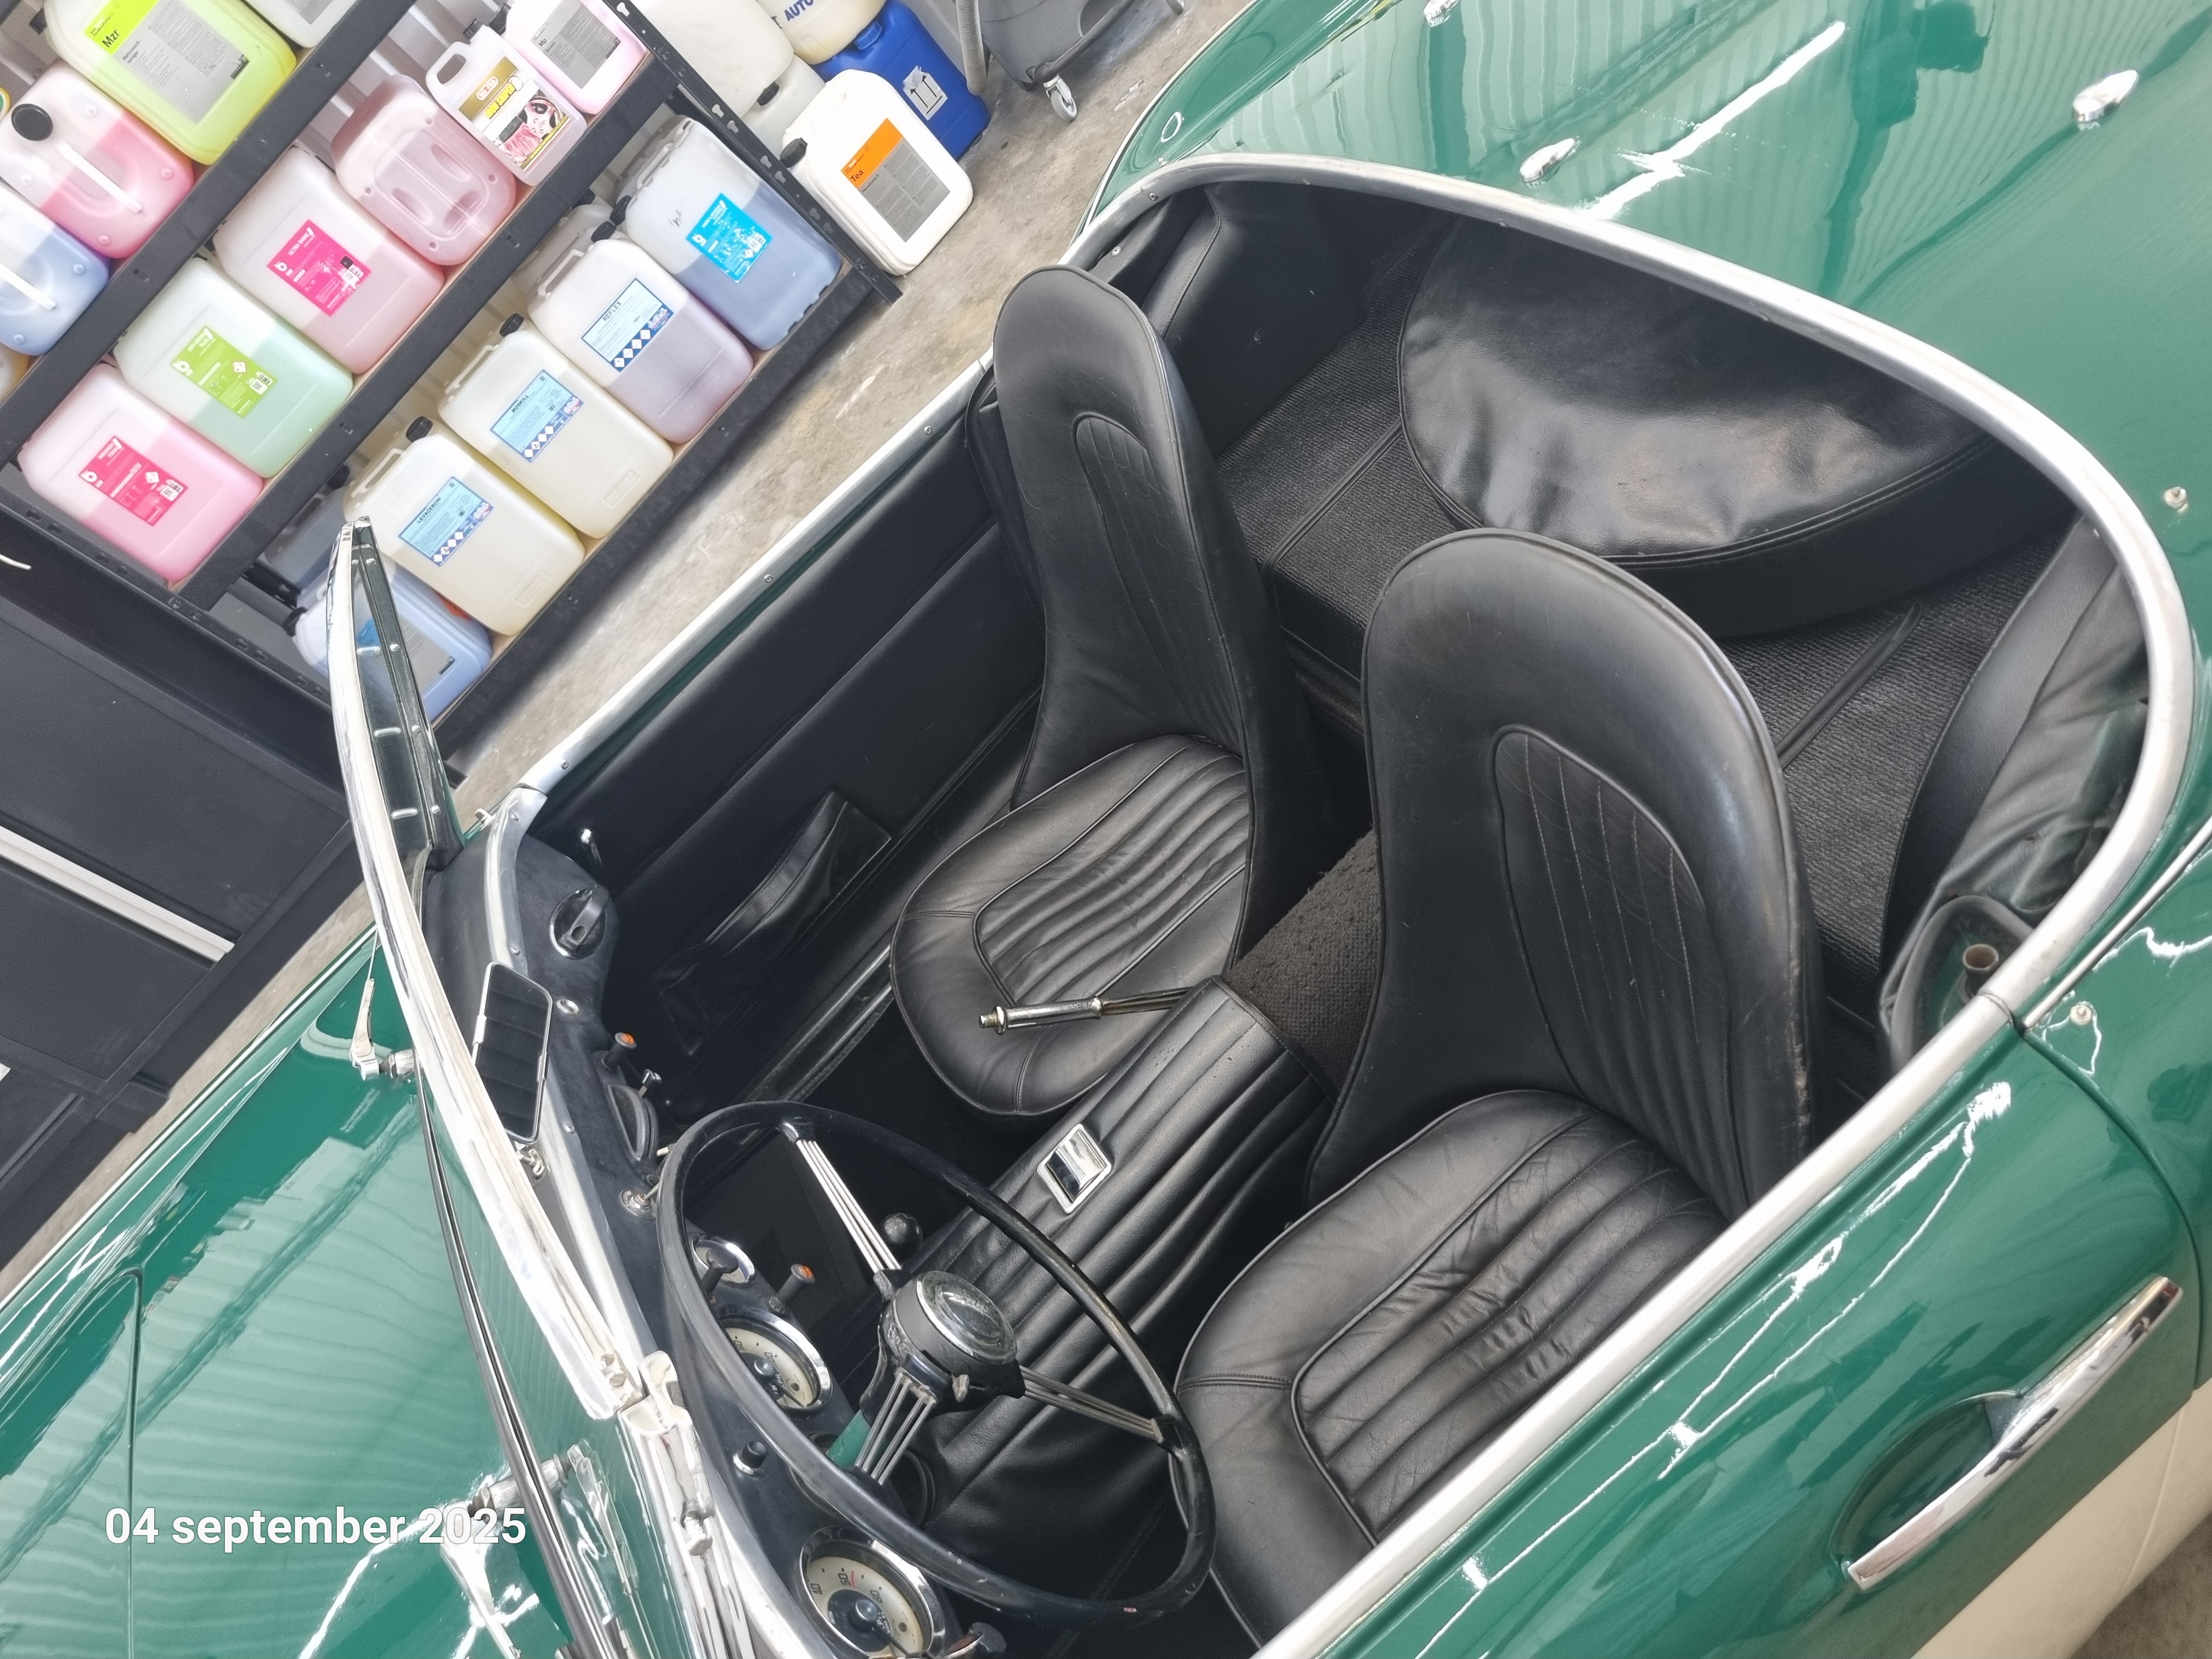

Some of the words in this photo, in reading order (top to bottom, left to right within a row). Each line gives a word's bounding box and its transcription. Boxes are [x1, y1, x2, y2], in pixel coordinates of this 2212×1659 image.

[101, 27, 121, 48] Mzr
[538, 37, 548, 48] Mp
[849, 168, 865, 183] Tea
[602, 300, 622, 321] REFLEX
[838, 1572, 851, 1587] 50
[810, 1583, 823, 1594] 40
[870, 1590, 883, 1602] 60
